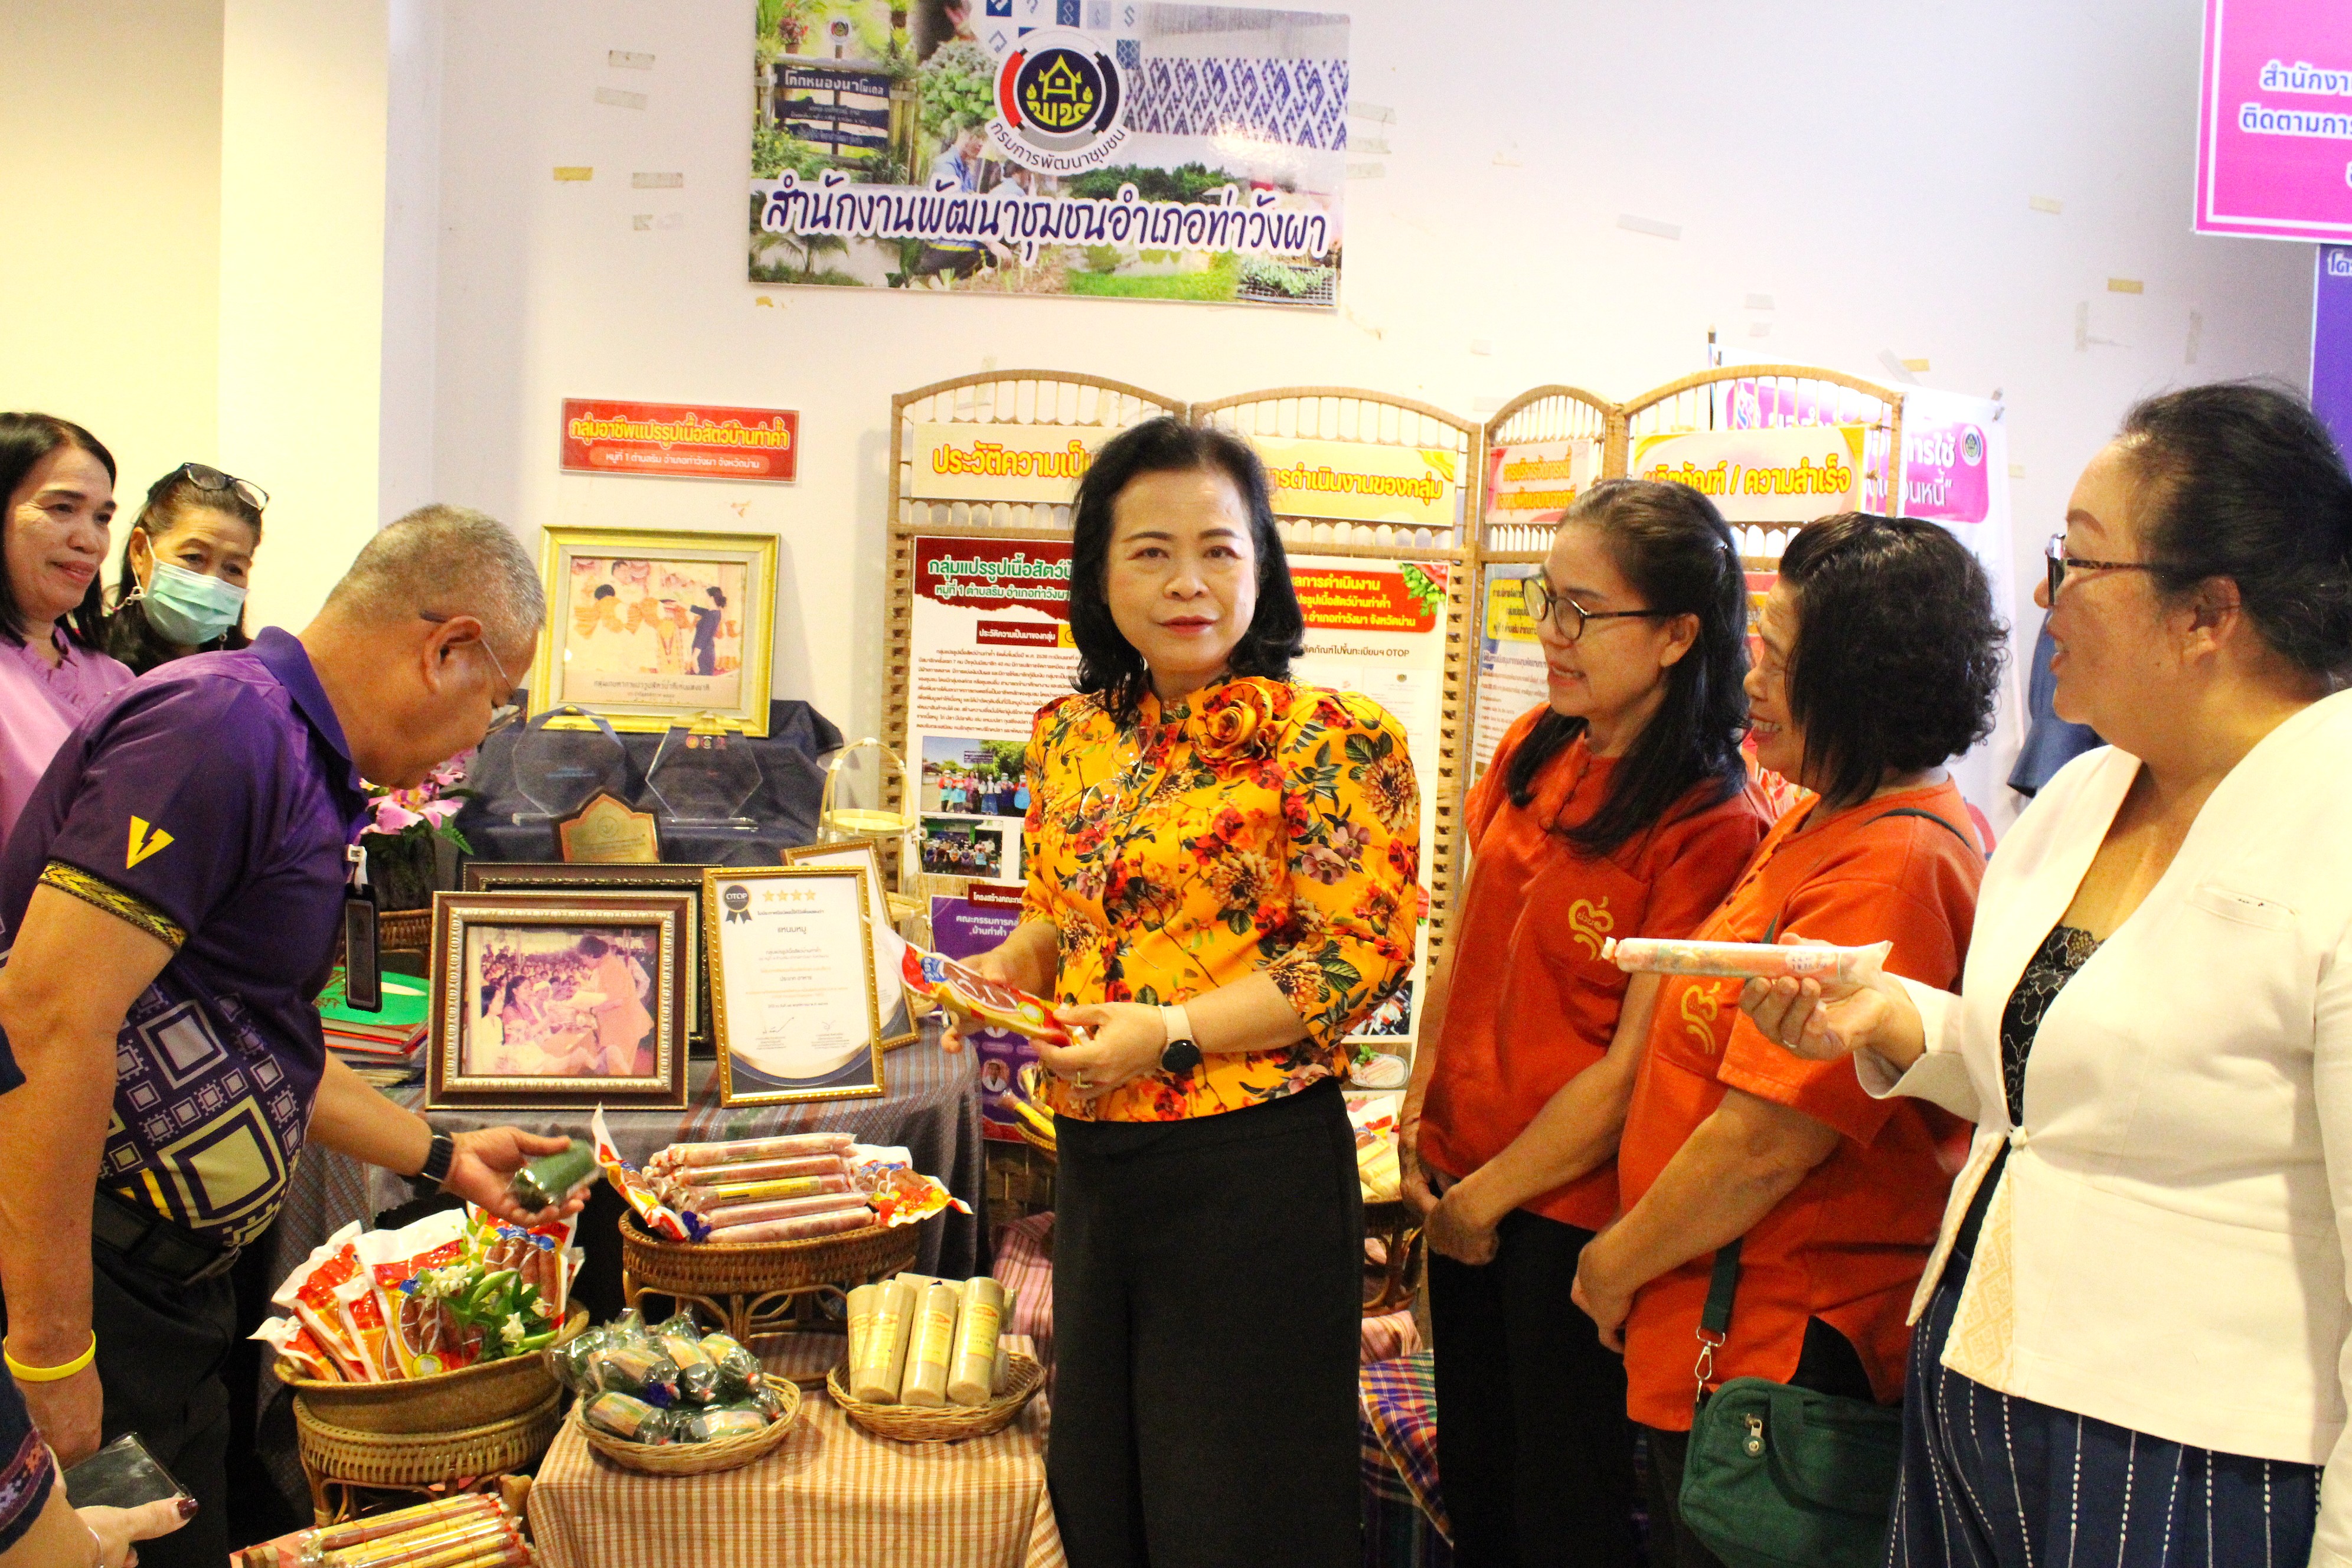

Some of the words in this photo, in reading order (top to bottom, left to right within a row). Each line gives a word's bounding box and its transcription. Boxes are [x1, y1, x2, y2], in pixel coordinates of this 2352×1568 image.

[2263, 63, 2352, 92] สำนักงา
[990, 122, 1126, 170] กรมการพัฒนาชุมชน
[765, 176, 1327, 260] สำนักงานพัฒนาชุมชนอำเภอท่าวังผา
[571, 414, 789, 449] กลุ่มอาชีพแปรรูปเนื้อสัตว์บ้านท่าค้ำ
[1269, 462, 1443, 506] ารดำเนินงานของกลุ่ม
[1744, 453, 1851, 495] ความสำเร็จ
[959, 586, 963, 596] 1
[1292, 573, 1380, 590] ลการดำเนินงาน
[1296, 591, 1391, 608] ปรรูปเนื้อสัตว์บ้านท่าค้ำ
[1386, 649, 1410, 657] OTOP
